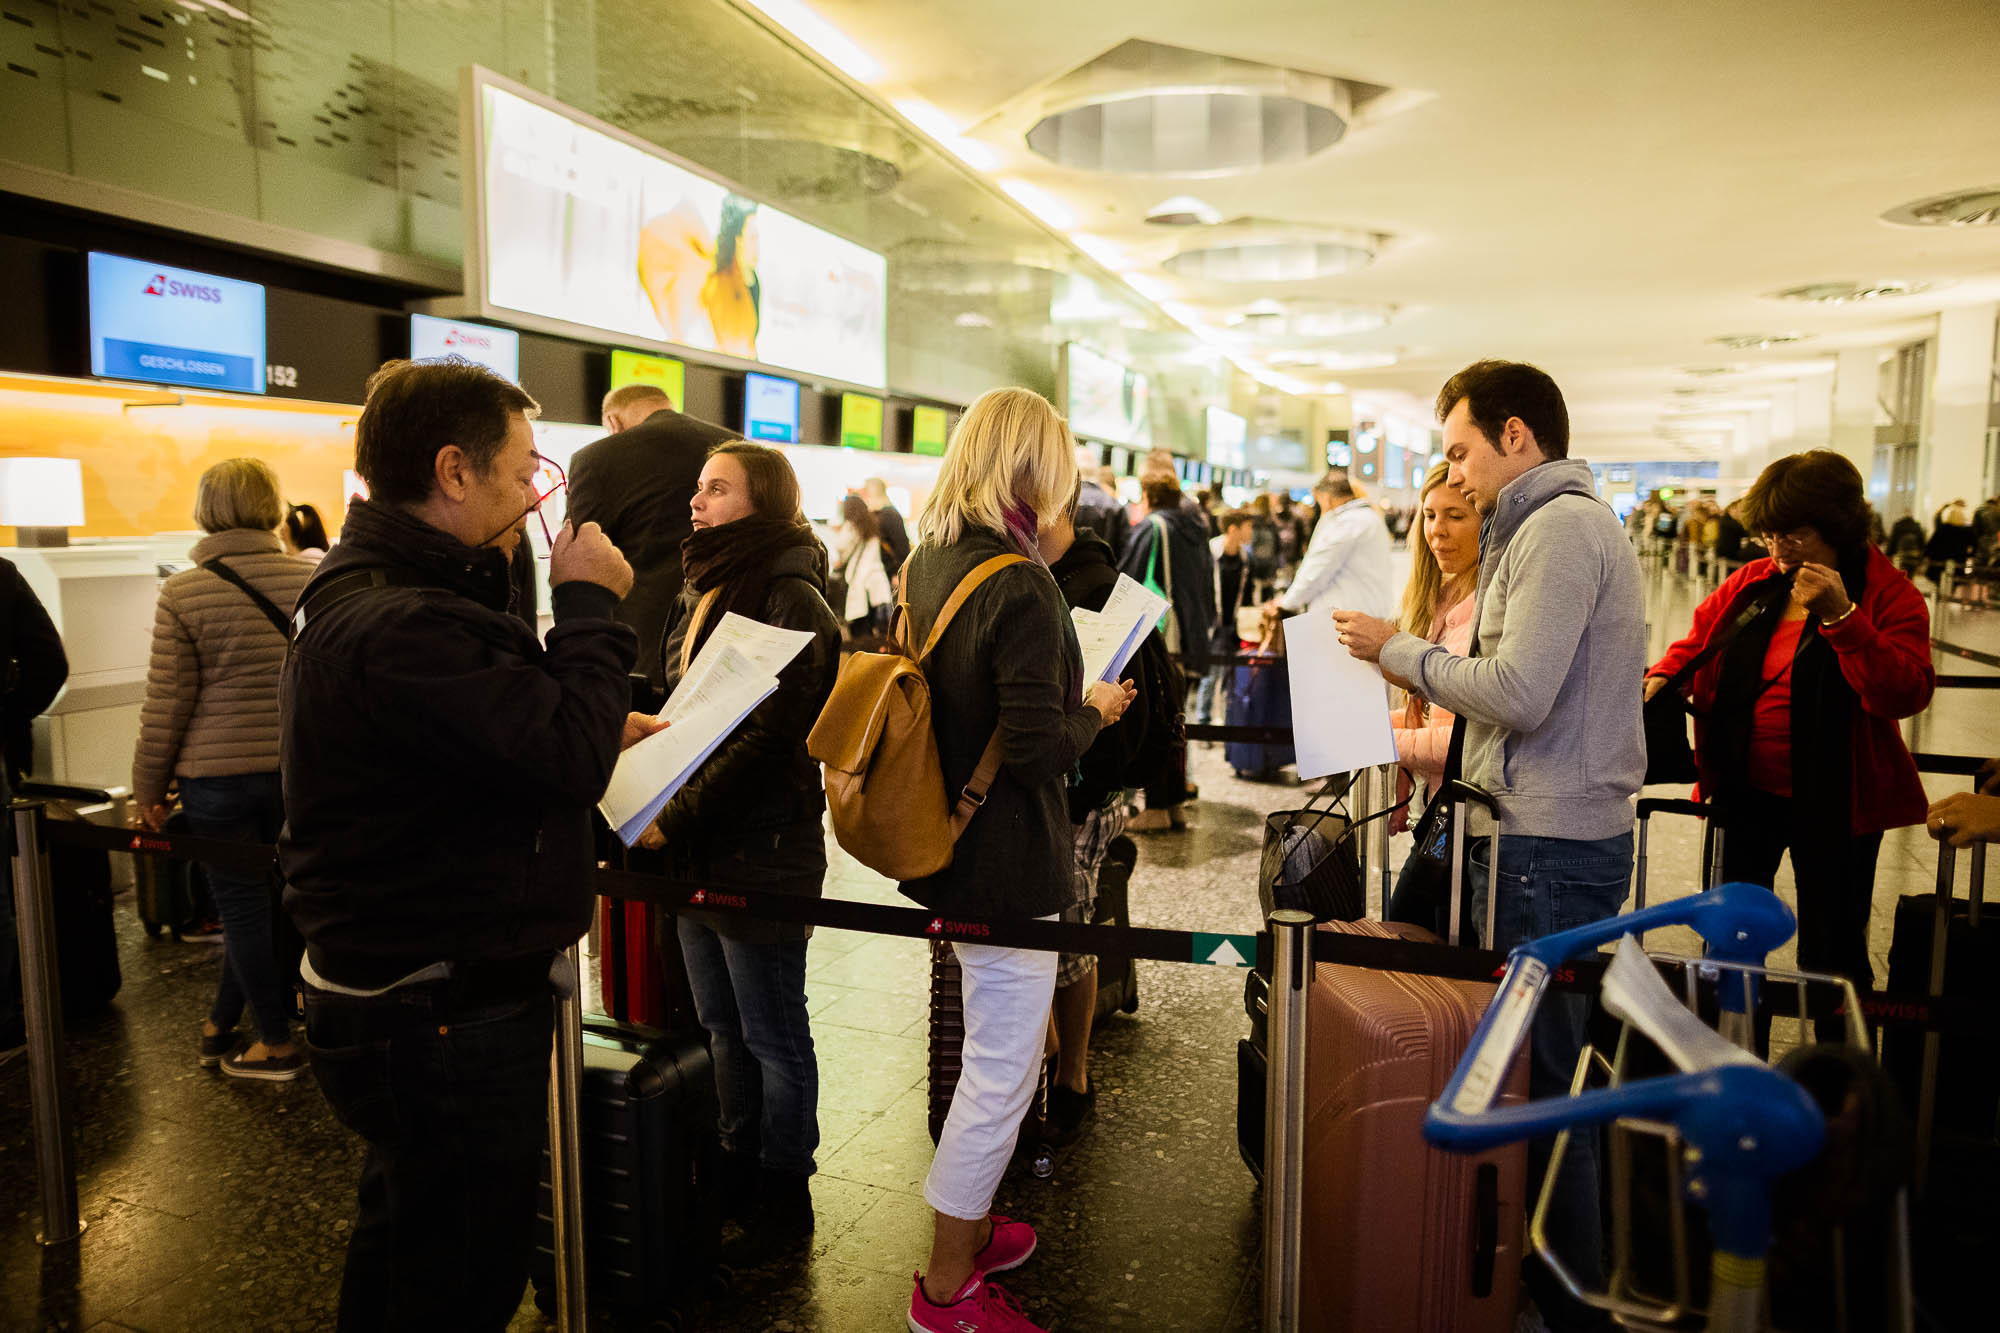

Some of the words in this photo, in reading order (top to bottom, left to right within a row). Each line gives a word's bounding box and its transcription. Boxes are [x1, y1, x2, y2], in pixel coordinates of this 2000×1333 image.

[168, 280, 222, 304] SWISS
[139, 354, 225, 376] GESCHLOSSEN
[266, 364, 298, 388] 152
[707, 892, 747, 908] SWISS
[945, 920, 990, 937] SWISS
[1863, 1001, 1929, 1021] SWISS
